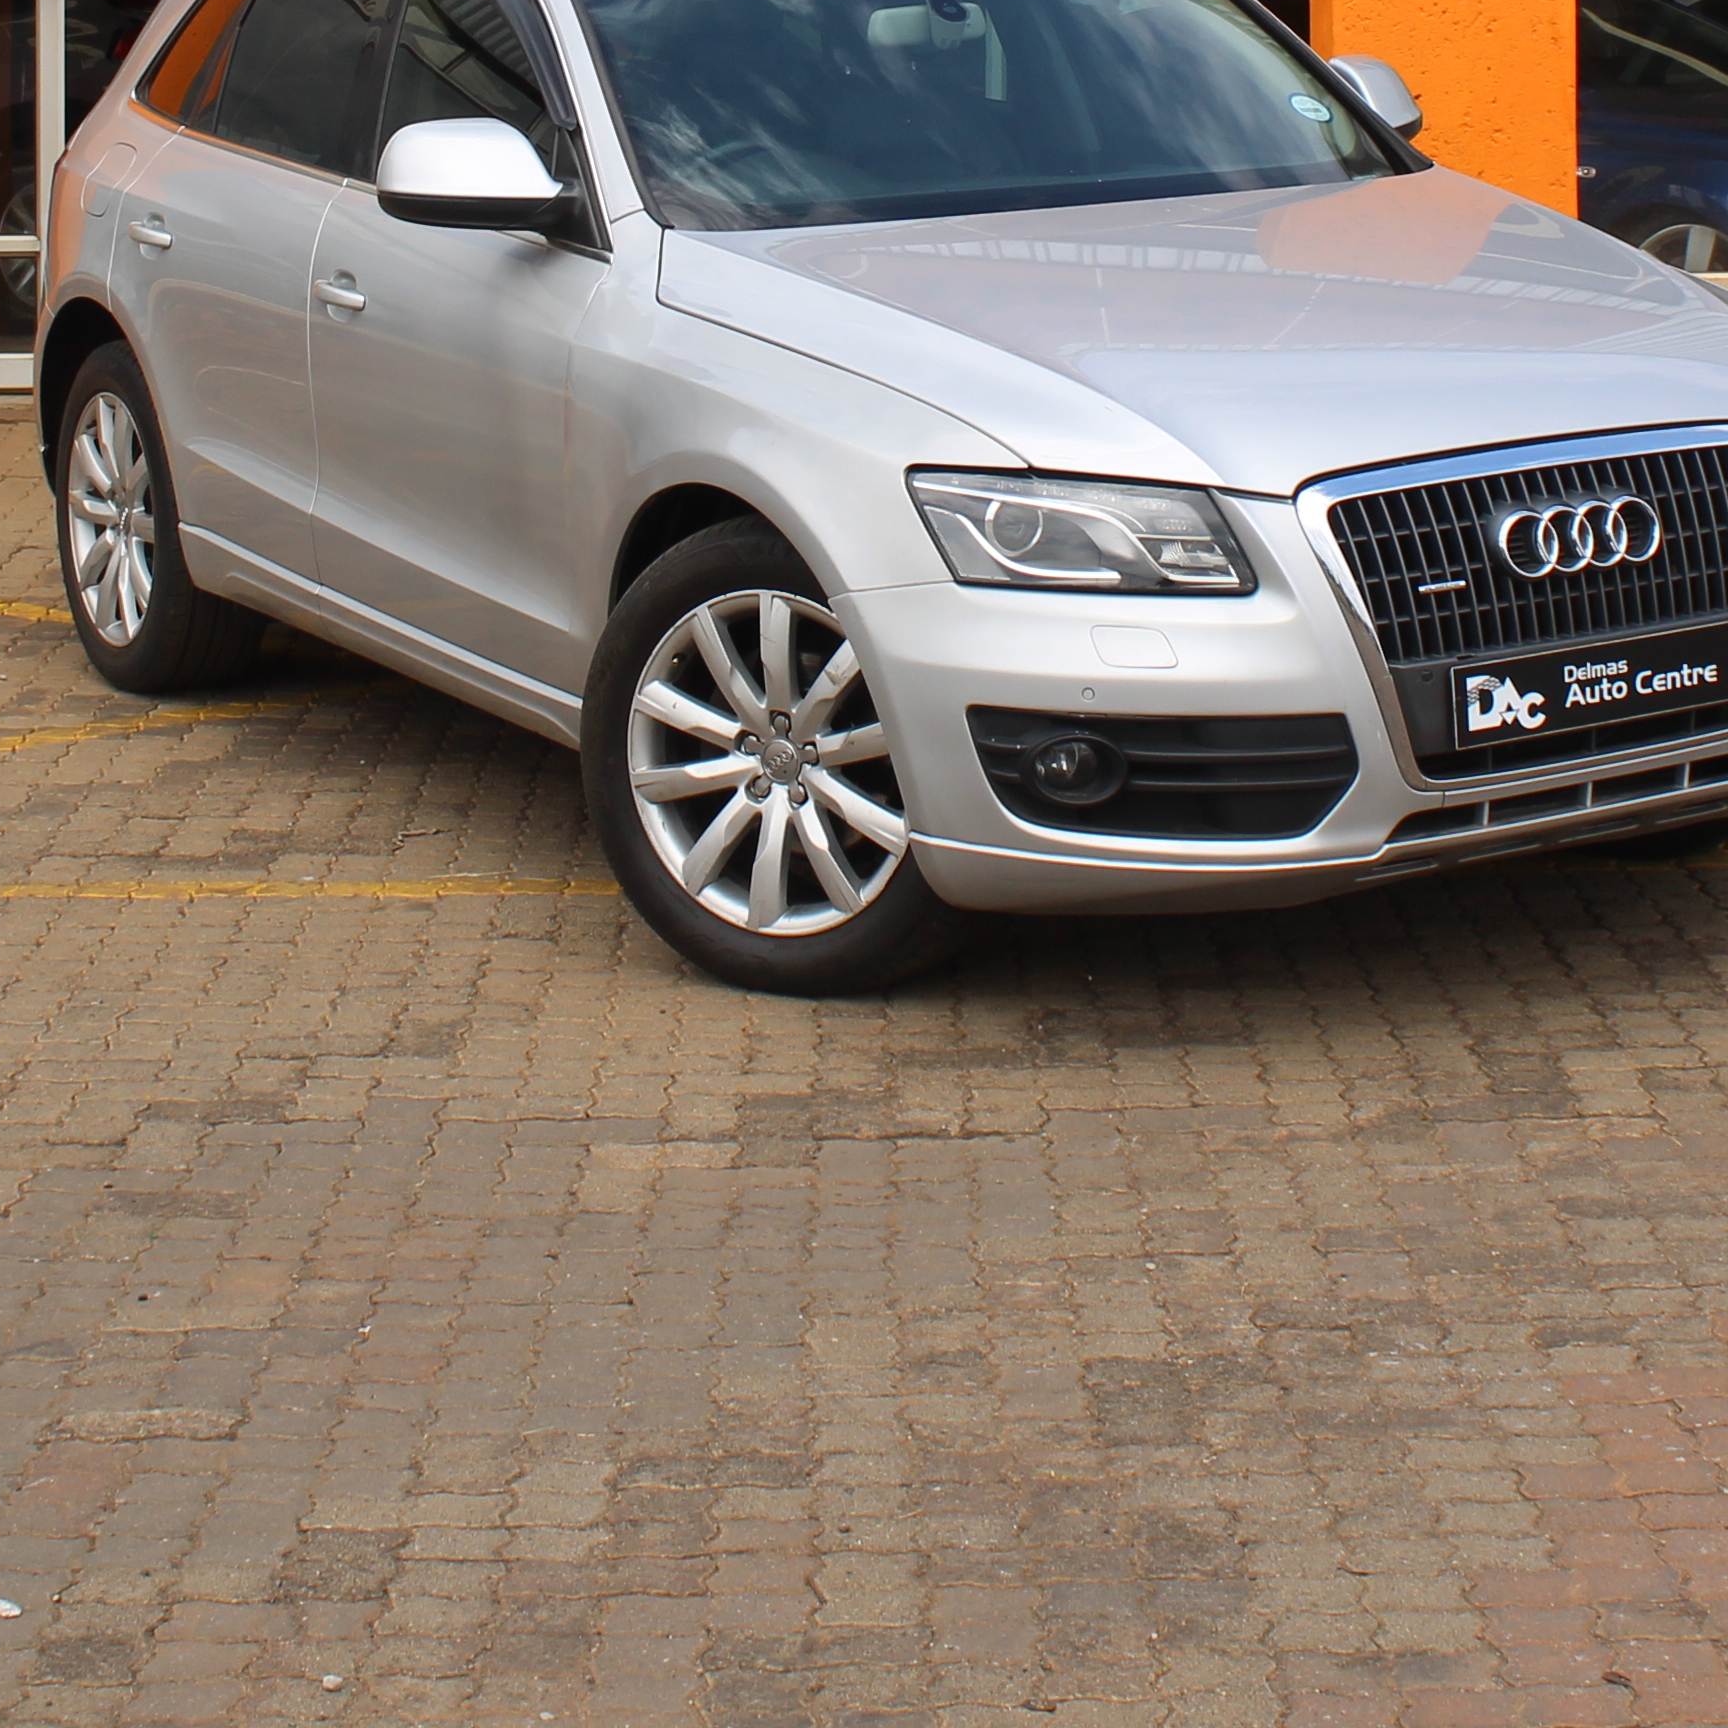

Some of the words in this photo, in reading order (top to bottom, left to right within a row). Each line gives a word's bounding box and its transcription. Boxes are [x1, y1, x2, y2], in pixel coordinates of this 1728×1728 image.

[1563, 659, 1629, 684] Delmas
[1564, 677, 1628, 709] Auto
[1634, 663, 1718, 695] Centre
[1465, 675, 1547, 732] DAC
